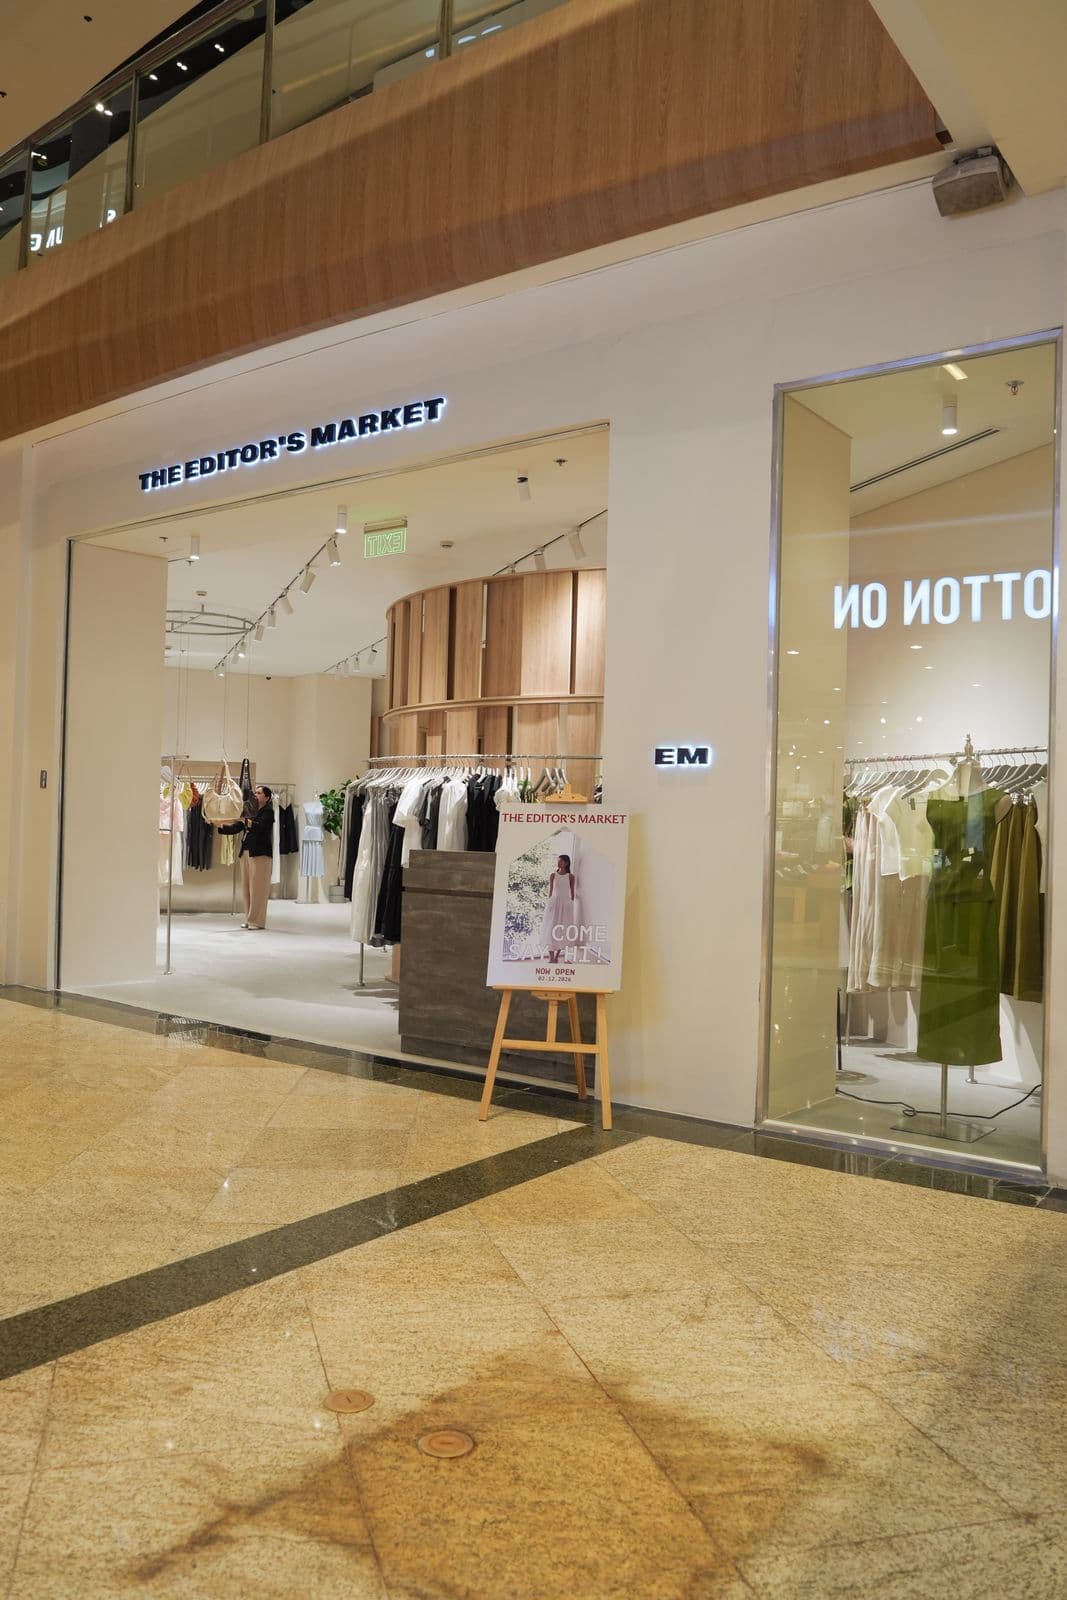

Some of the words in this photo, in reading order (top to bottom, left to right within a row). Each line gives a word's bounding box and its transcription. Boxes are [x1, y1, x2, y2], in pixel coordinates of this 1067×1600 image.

[138, 466, 182, 491] THE
[184, 432, 306, 479] EDITOR'S
[310, 398, 445, 447] MARKET
[654, 747, 709, 765] EM
[502, 813, 524, 823] THE
[526, 814, 576, 824] EDITOR'S
[578, 814, 627, 824] MARKET
[552, 924, 607, 942] COME
[509, 943, 549, 961] SAY
[564, 945, 601, 964] HI!
[535, 967, 551, 975] NOW
[554, 968, 576, 976] OPEN
